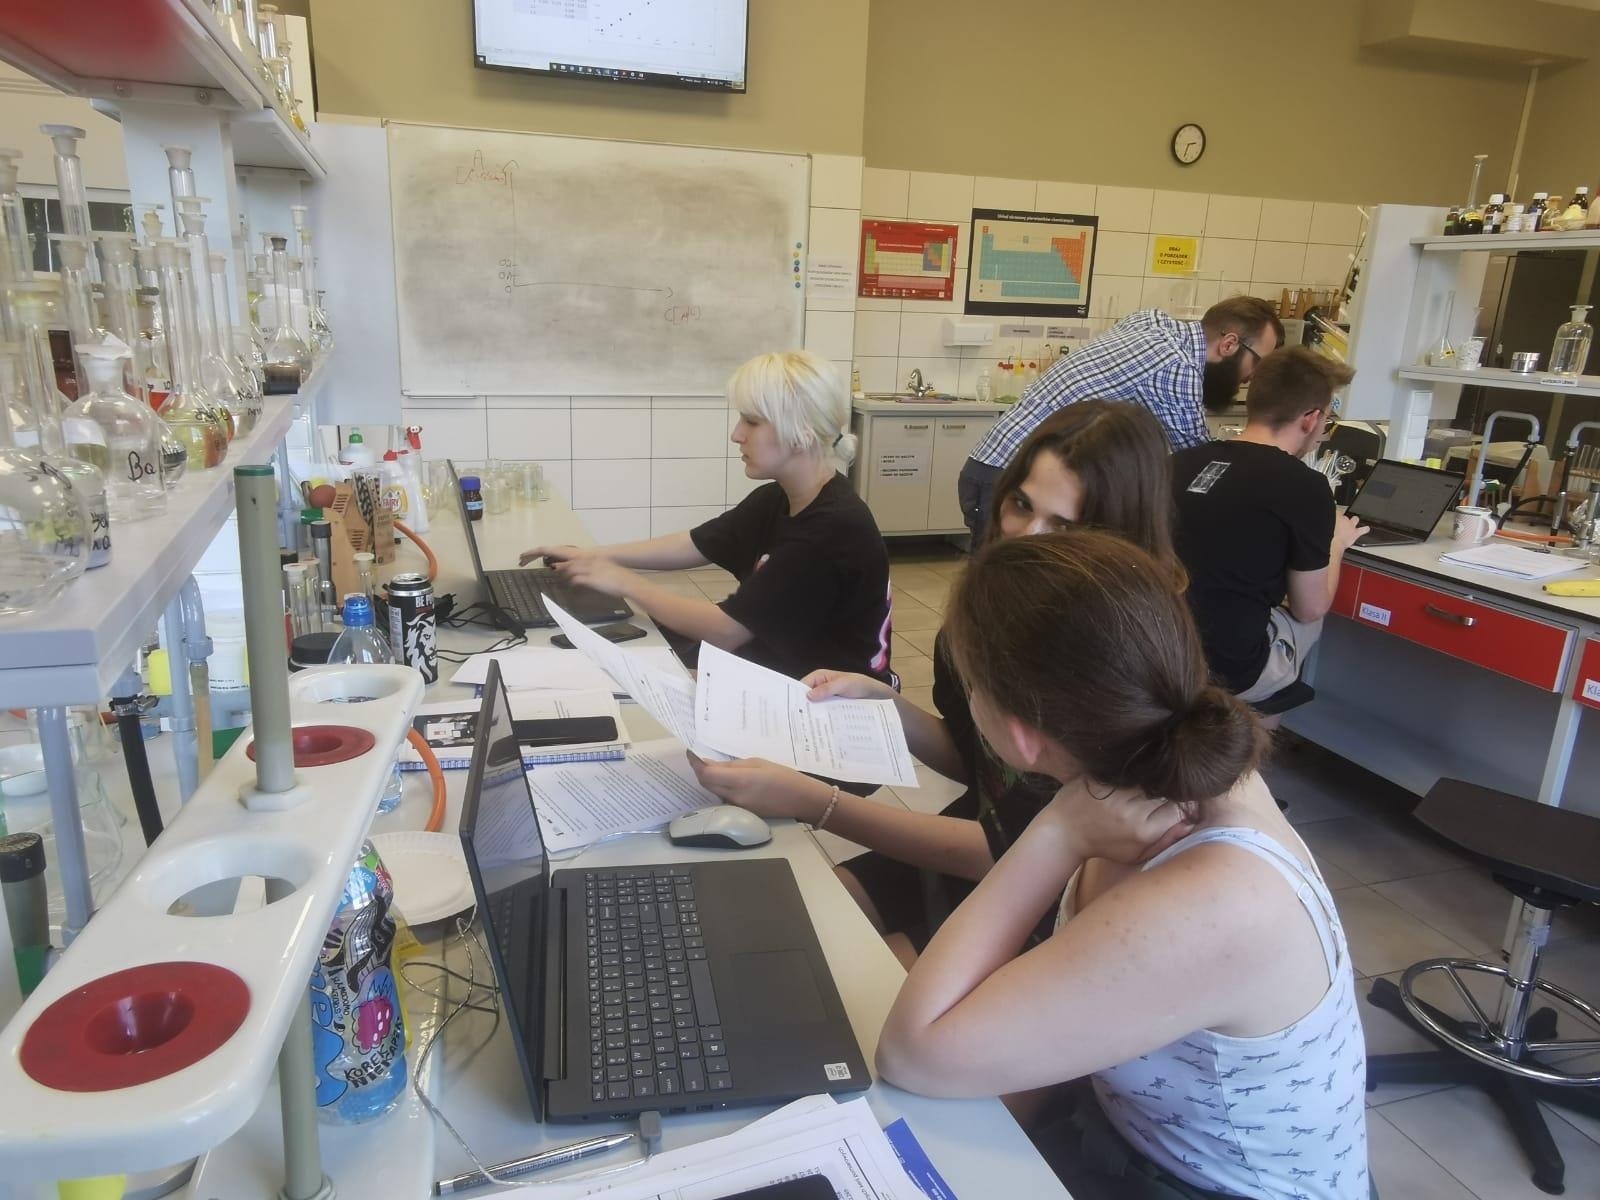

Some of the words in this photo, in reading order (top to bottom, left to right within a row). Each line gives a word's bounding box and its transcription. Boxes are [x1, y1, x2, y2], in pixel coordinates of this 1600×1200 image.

[128, 451, 156, 481] Ba
[416, 596, 425, 608] BE
[1362, 606, 1380, 619] Klasa
[344, 1042, 388, 1081] KOREK
